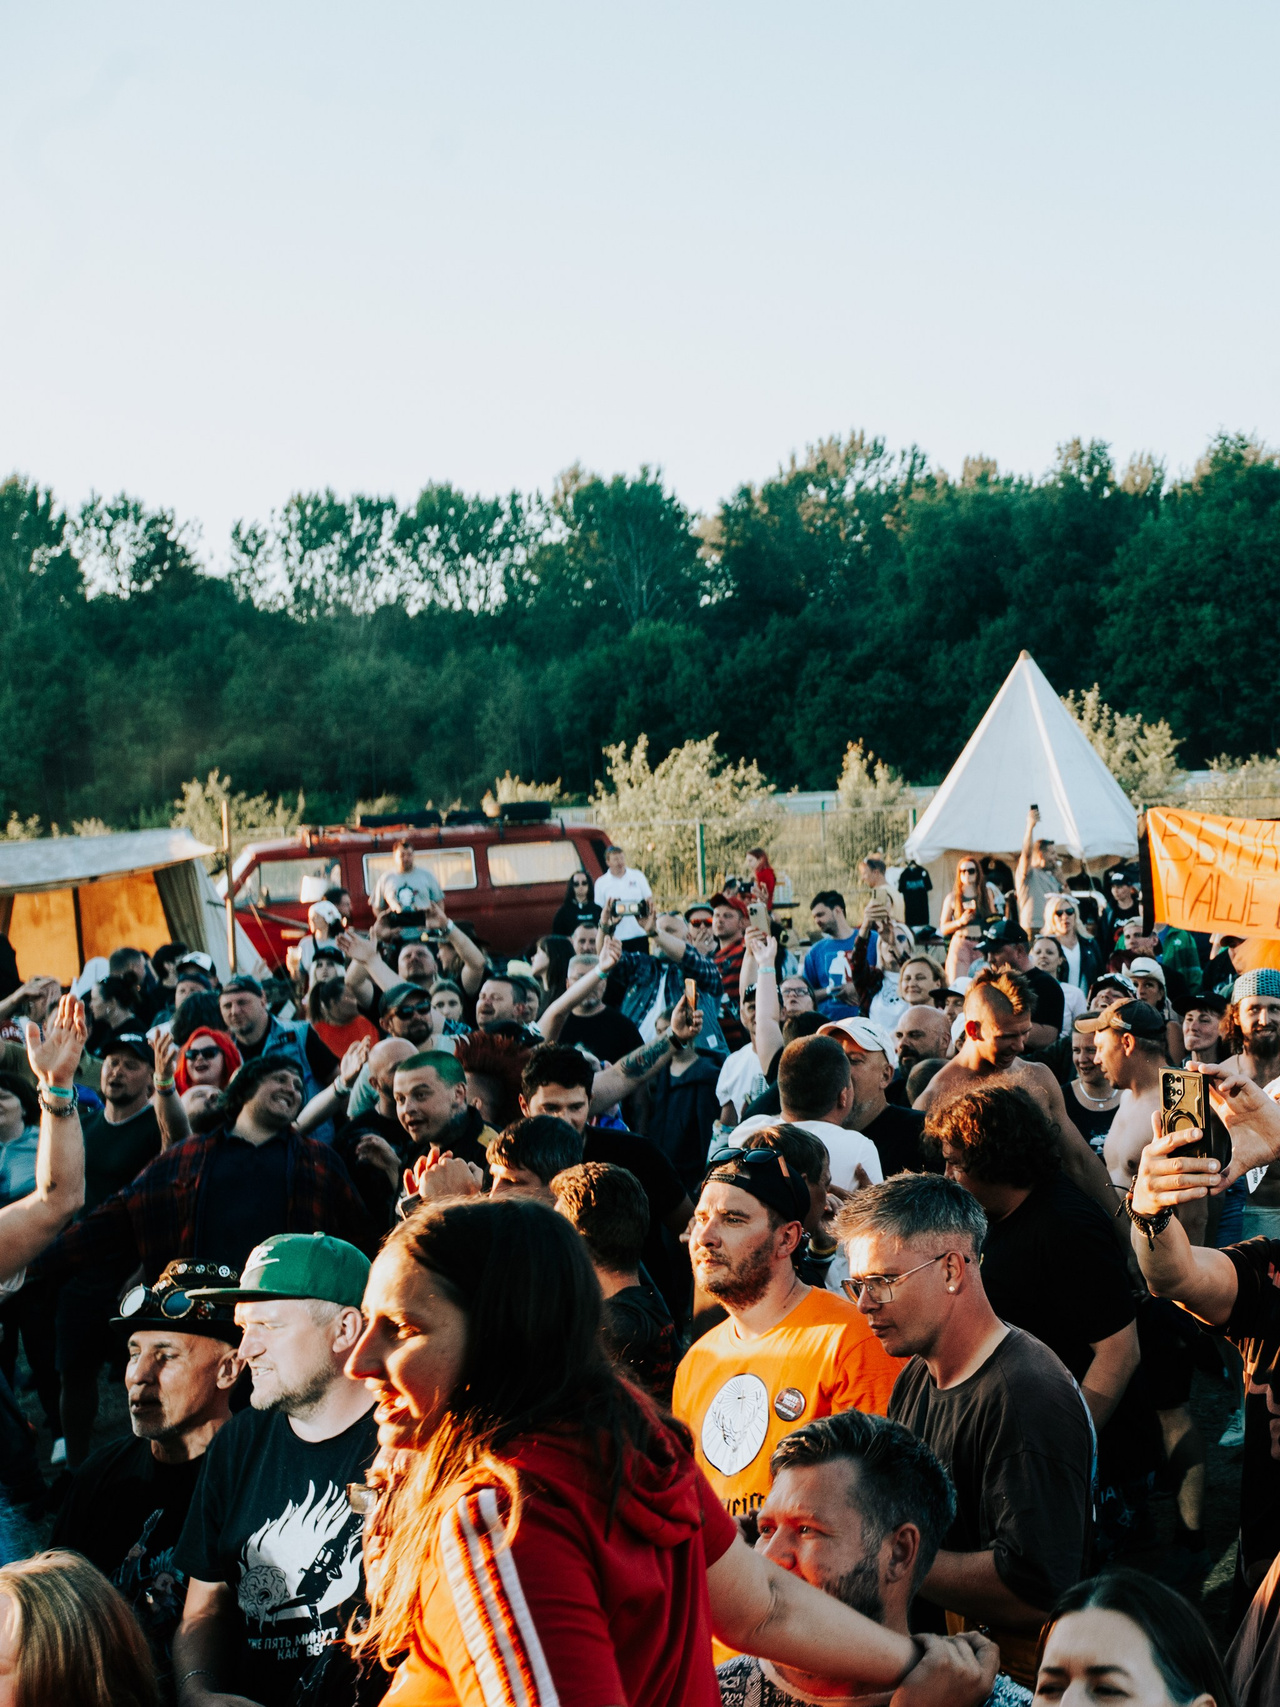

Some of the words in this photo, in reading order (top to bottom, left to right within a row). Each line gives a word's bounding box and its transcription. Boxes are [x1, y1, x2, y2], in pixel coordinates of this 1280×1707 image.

[1160, 813, 1232, 868] ВЫ
[1166, 868, 1266, 927] НАШЕ
[264, 1636, 292, 1650] ПЯТЬ
[295, 1627, 339, 1647] МИНУТ
[277, 1648, 300, 1661] КАК
